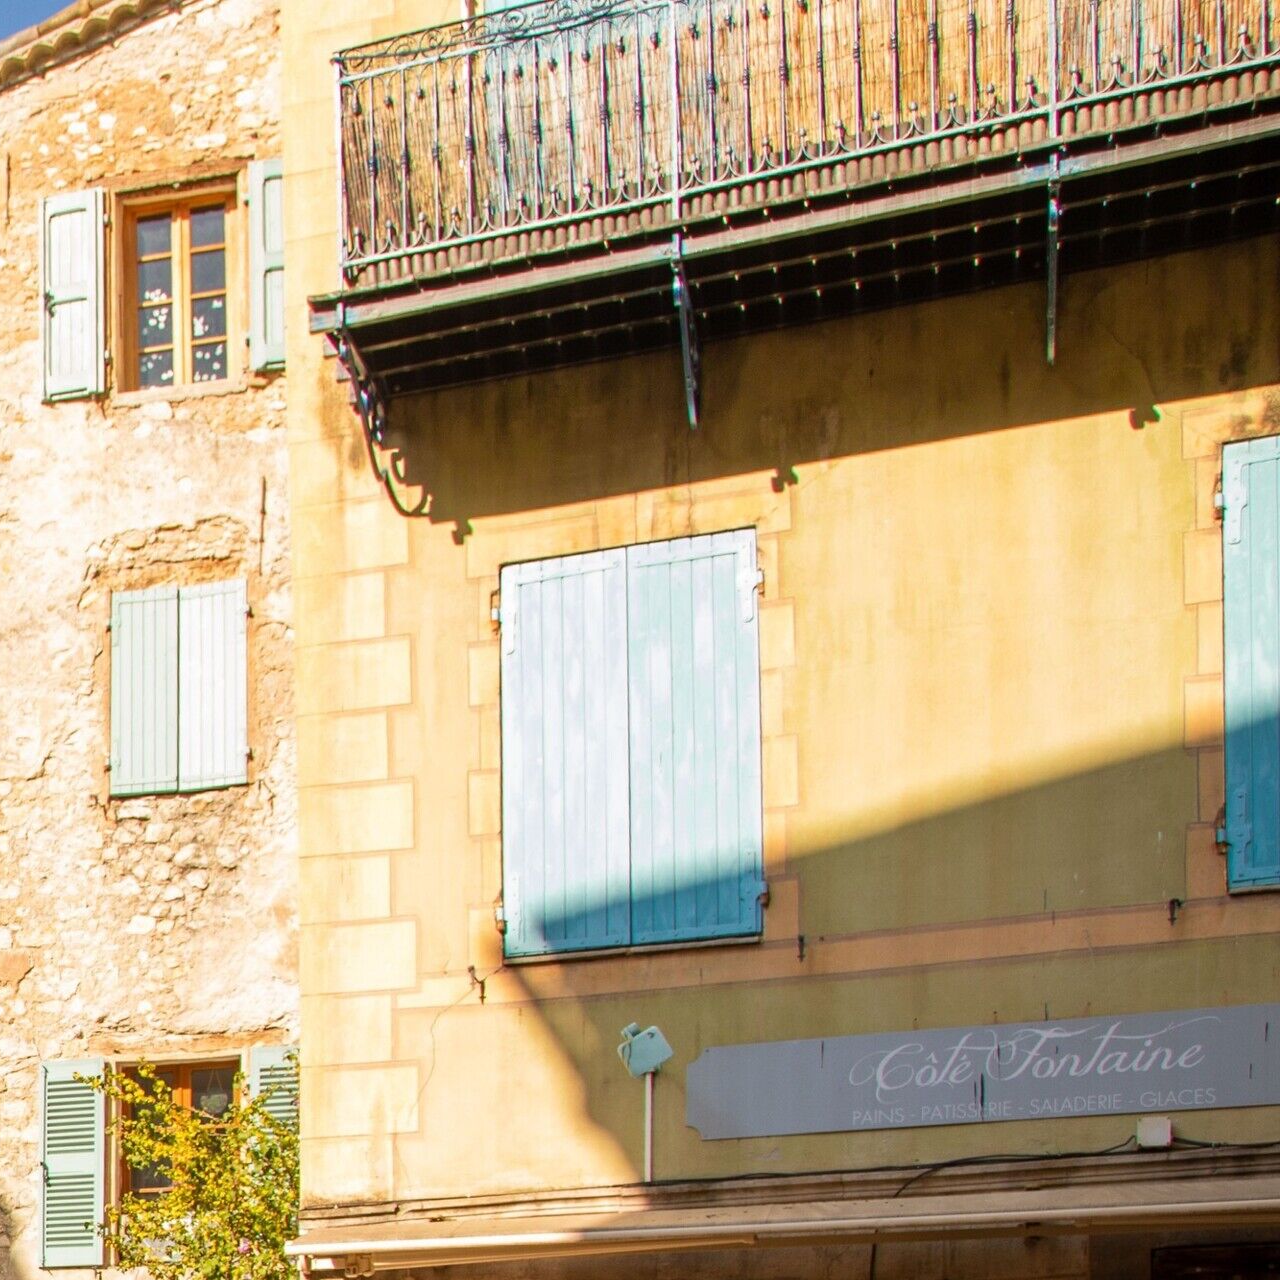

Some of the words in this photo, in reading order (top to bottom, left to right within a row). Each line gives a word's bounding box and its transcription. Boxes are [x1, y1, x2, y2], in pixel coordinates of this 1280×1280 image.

[986, 1016, 1221, 1081] Fontaine
[852, 1107, 904, 1126] PAINS
[1030, 1093, 1122, 1115] SALADERIE
[1139, 1087, 1216, 1107] GLACES
